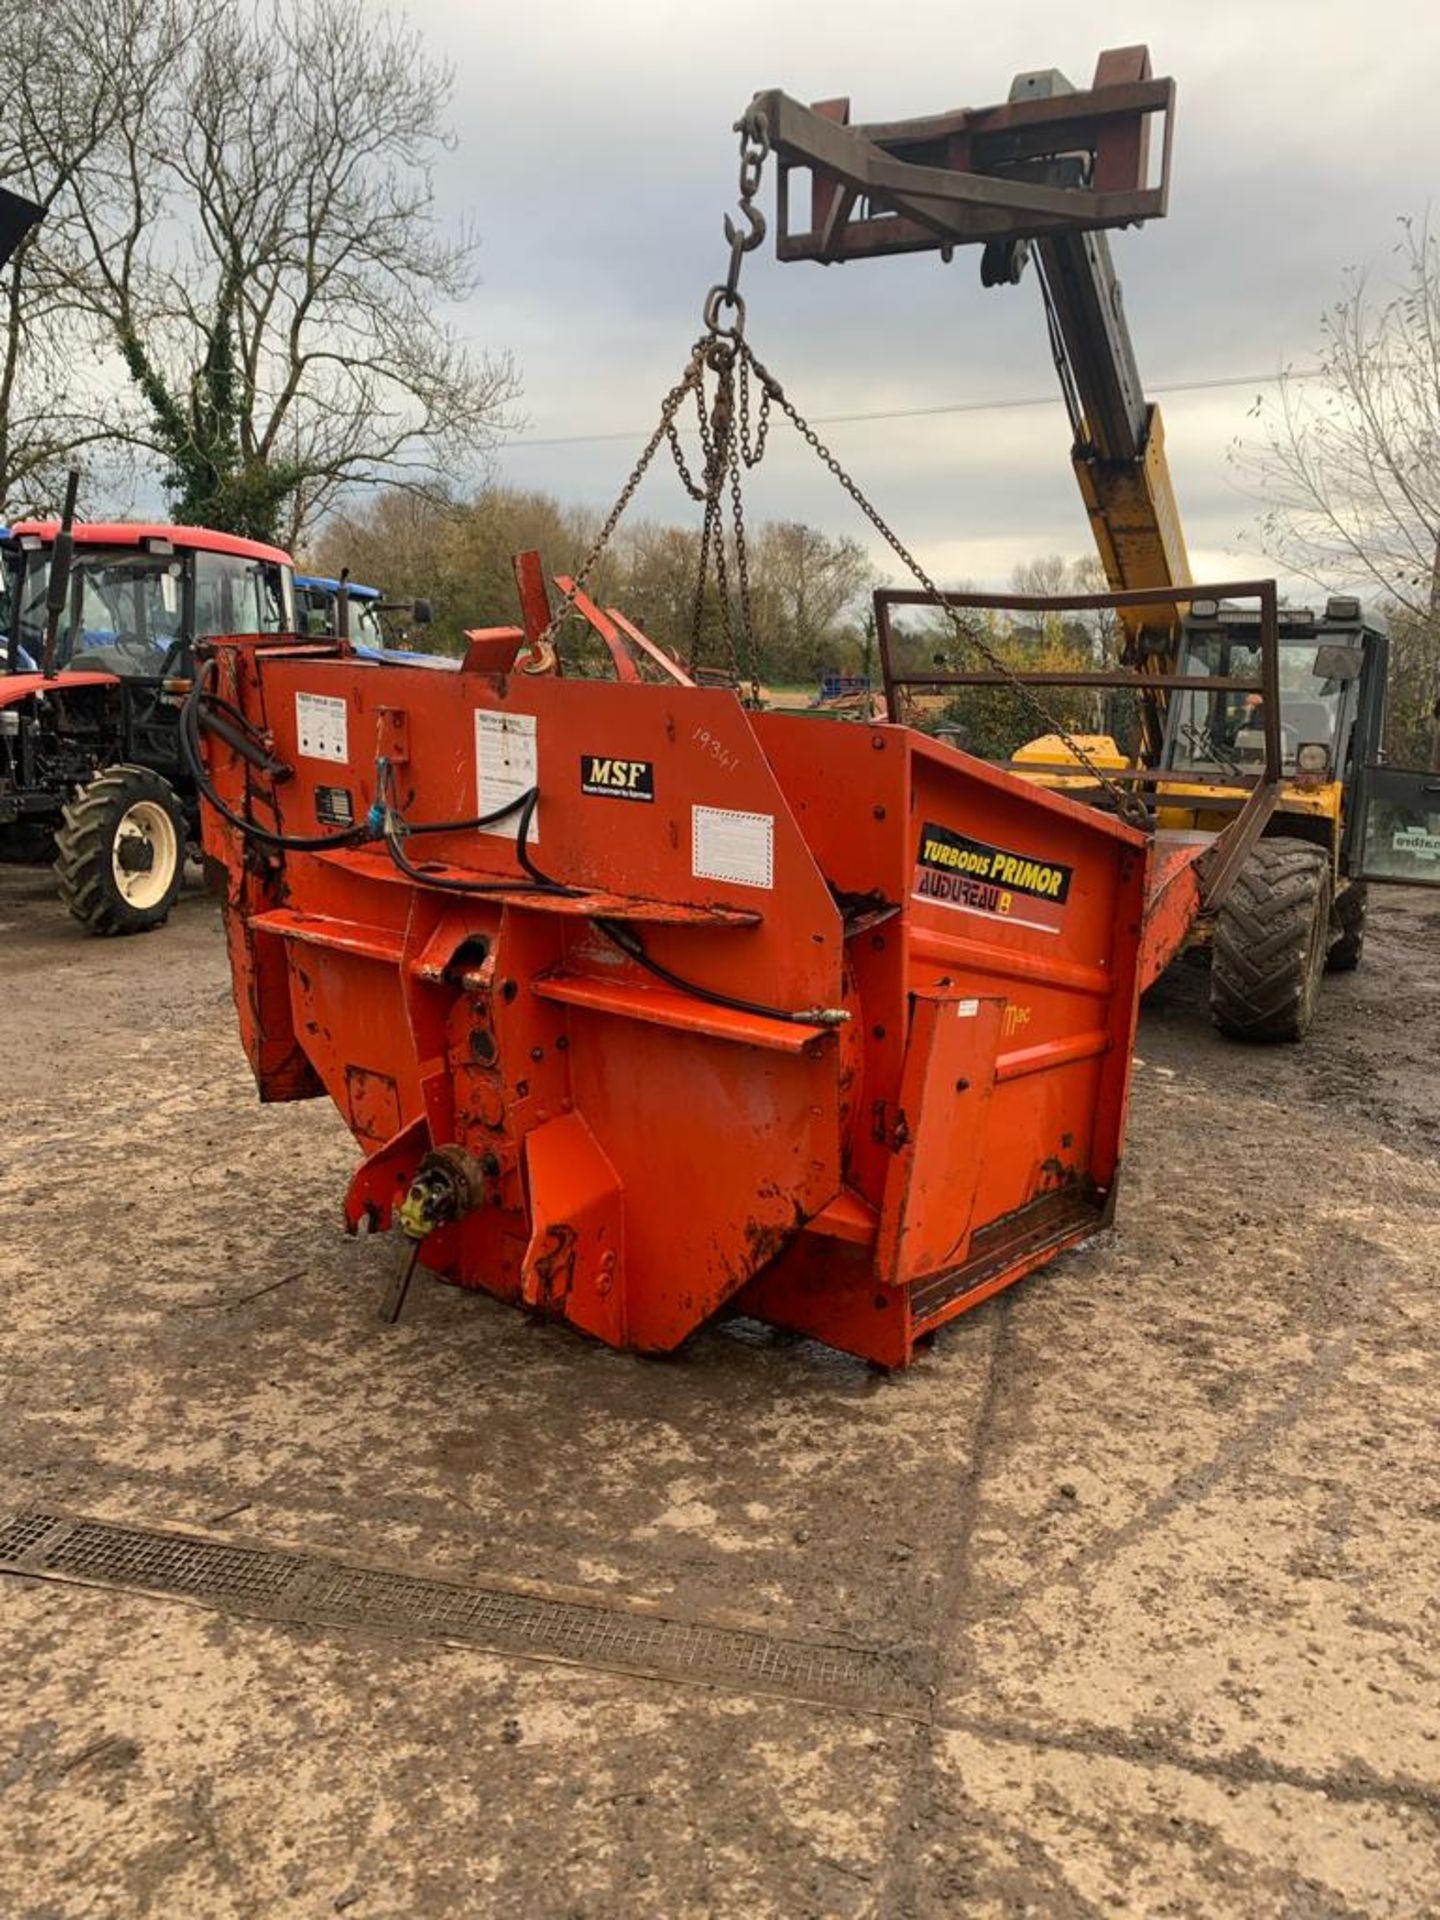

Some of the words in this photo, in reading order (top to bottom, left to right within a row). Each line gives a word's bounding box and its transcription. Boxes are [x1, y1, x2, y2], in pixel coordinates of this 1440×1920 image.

[589, 758, 646, 788] MSF
[923, 840, 990, 876] TURBODIS
[989, 854, 1062, 896] PRIMOR
[919, 871, 998, 911] AUDUREAU
